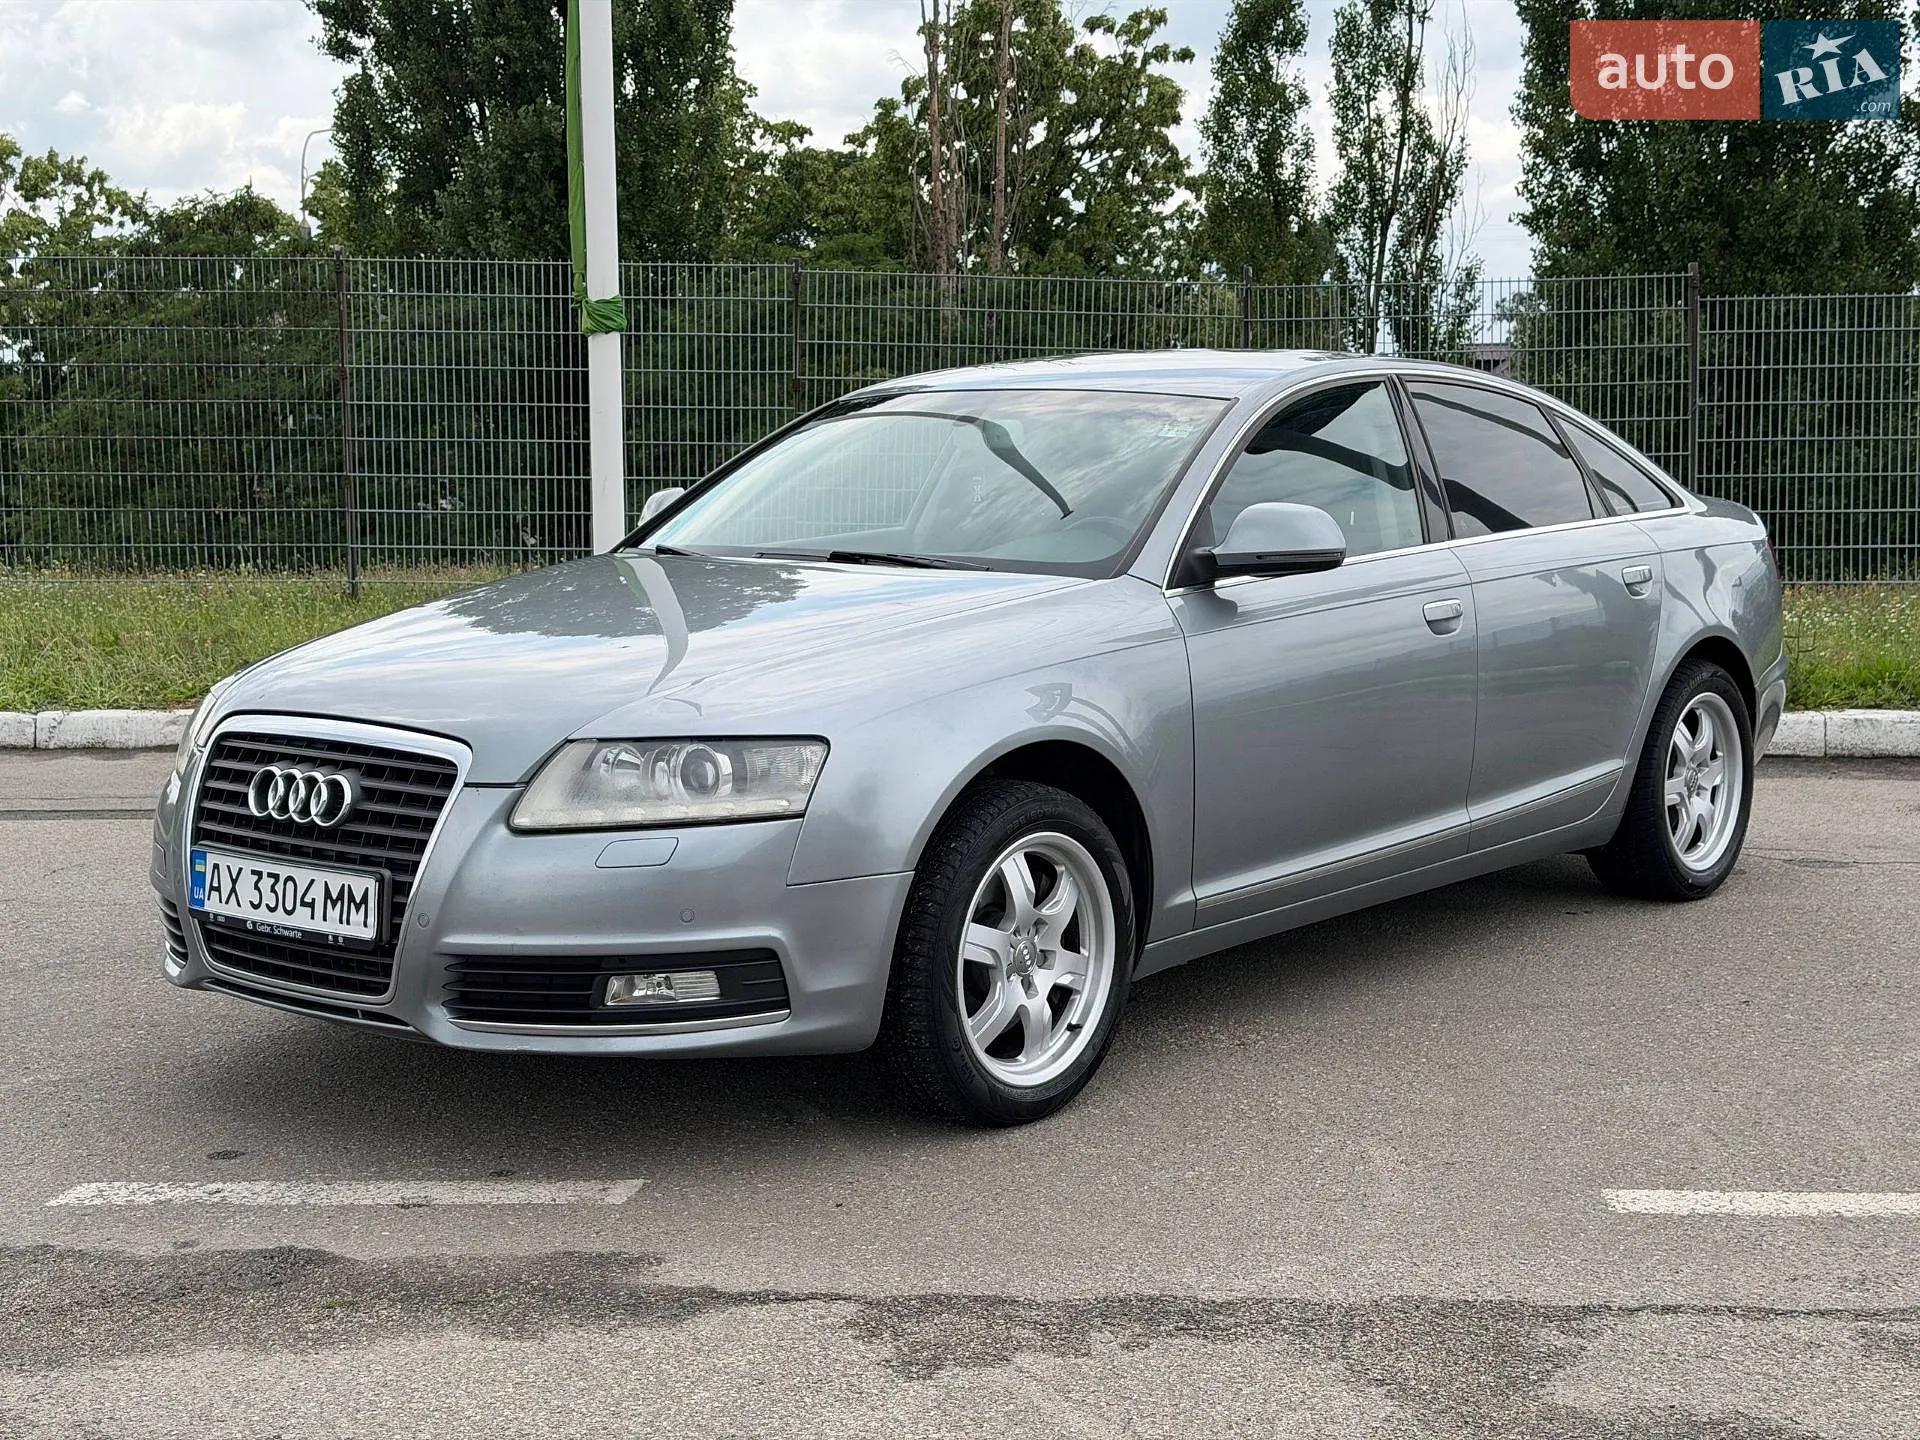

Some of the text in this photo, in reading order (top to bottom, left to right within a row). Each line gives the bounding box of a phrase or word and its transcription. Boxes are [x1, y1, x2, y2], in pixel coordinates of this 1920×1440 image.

[193, 885, 204, 900] UA
[207, 862, 369, 928] AX 3304 MM
[256, 922, 302, 939] Gebr. Schwarte
